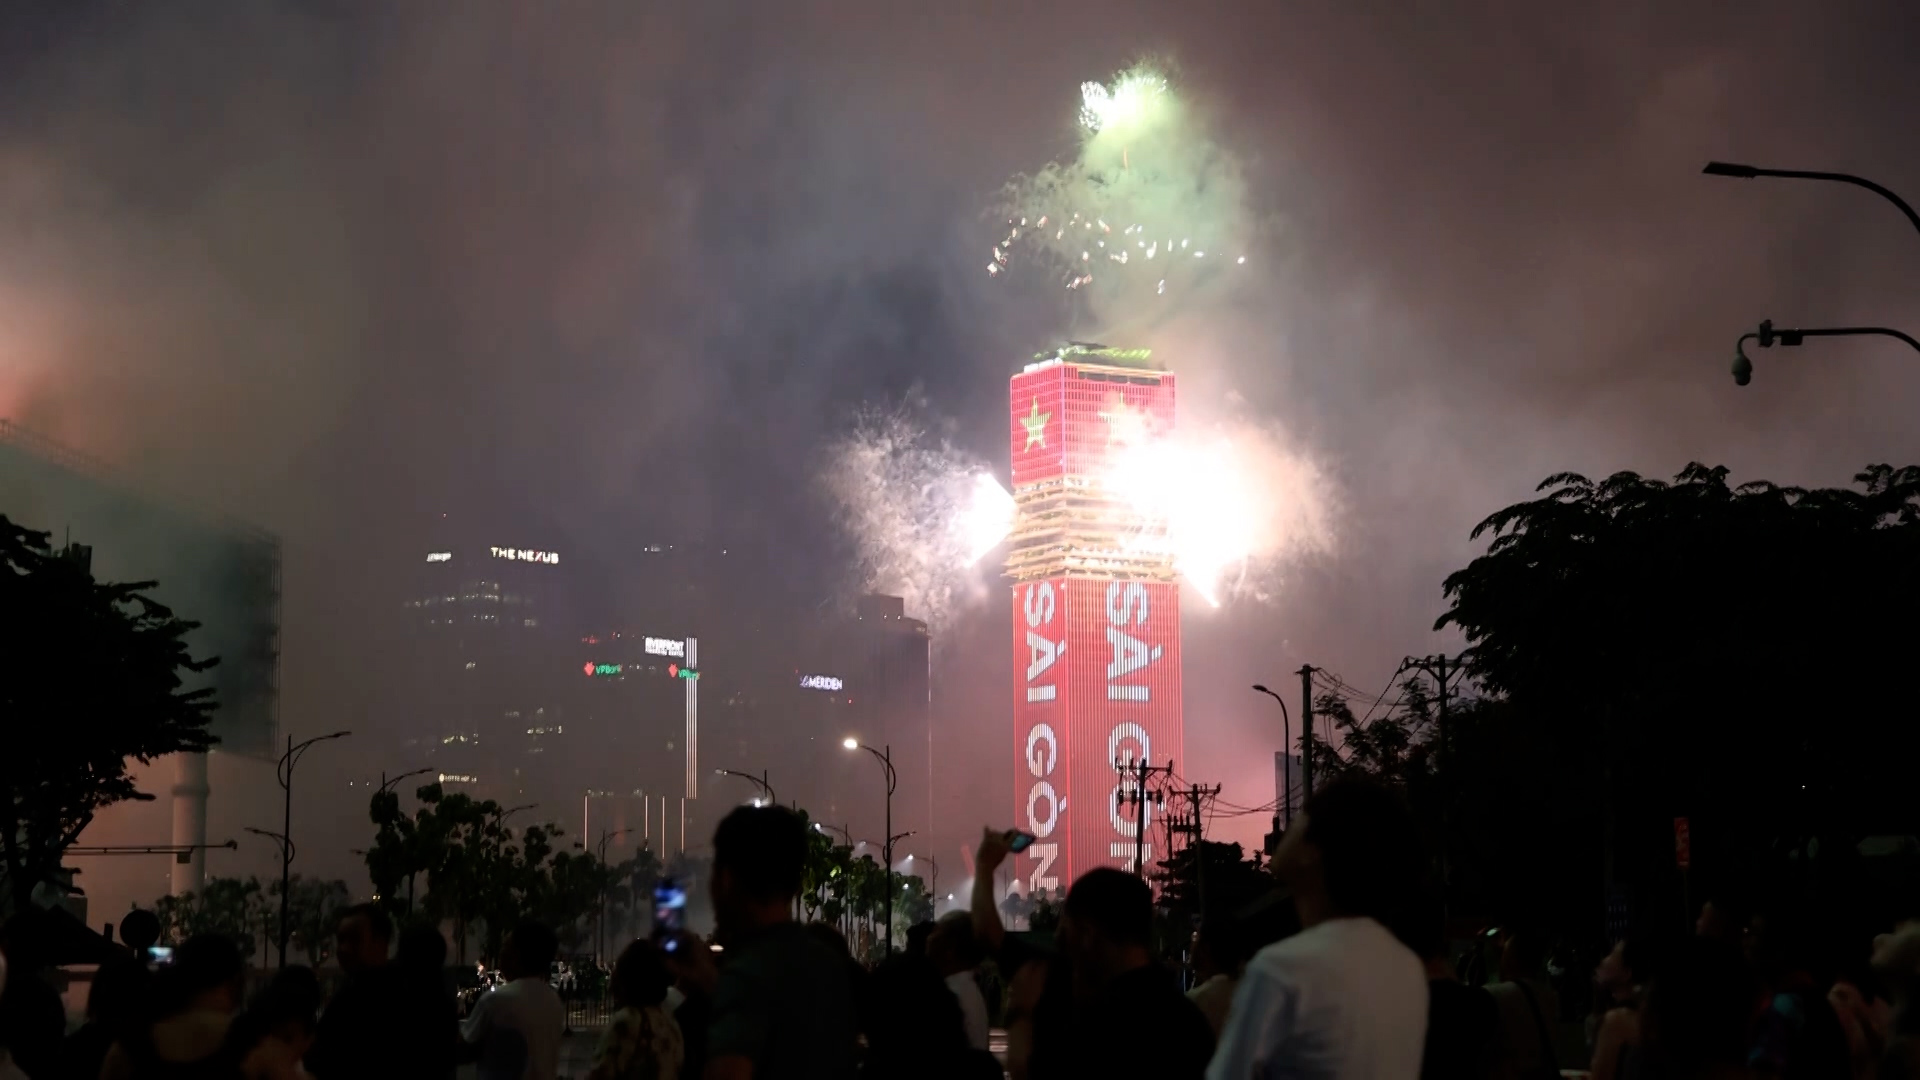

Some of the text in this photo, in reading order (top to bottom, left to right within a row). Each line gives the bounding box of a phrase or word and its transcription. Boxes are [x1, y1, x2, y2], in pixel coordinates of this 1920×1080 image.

[491, 547, 559, 564] THE NEXUS
[1106, 580, 1163, 702] SÀI
[1024, 581, 1067, 892] SÀI GÒN
